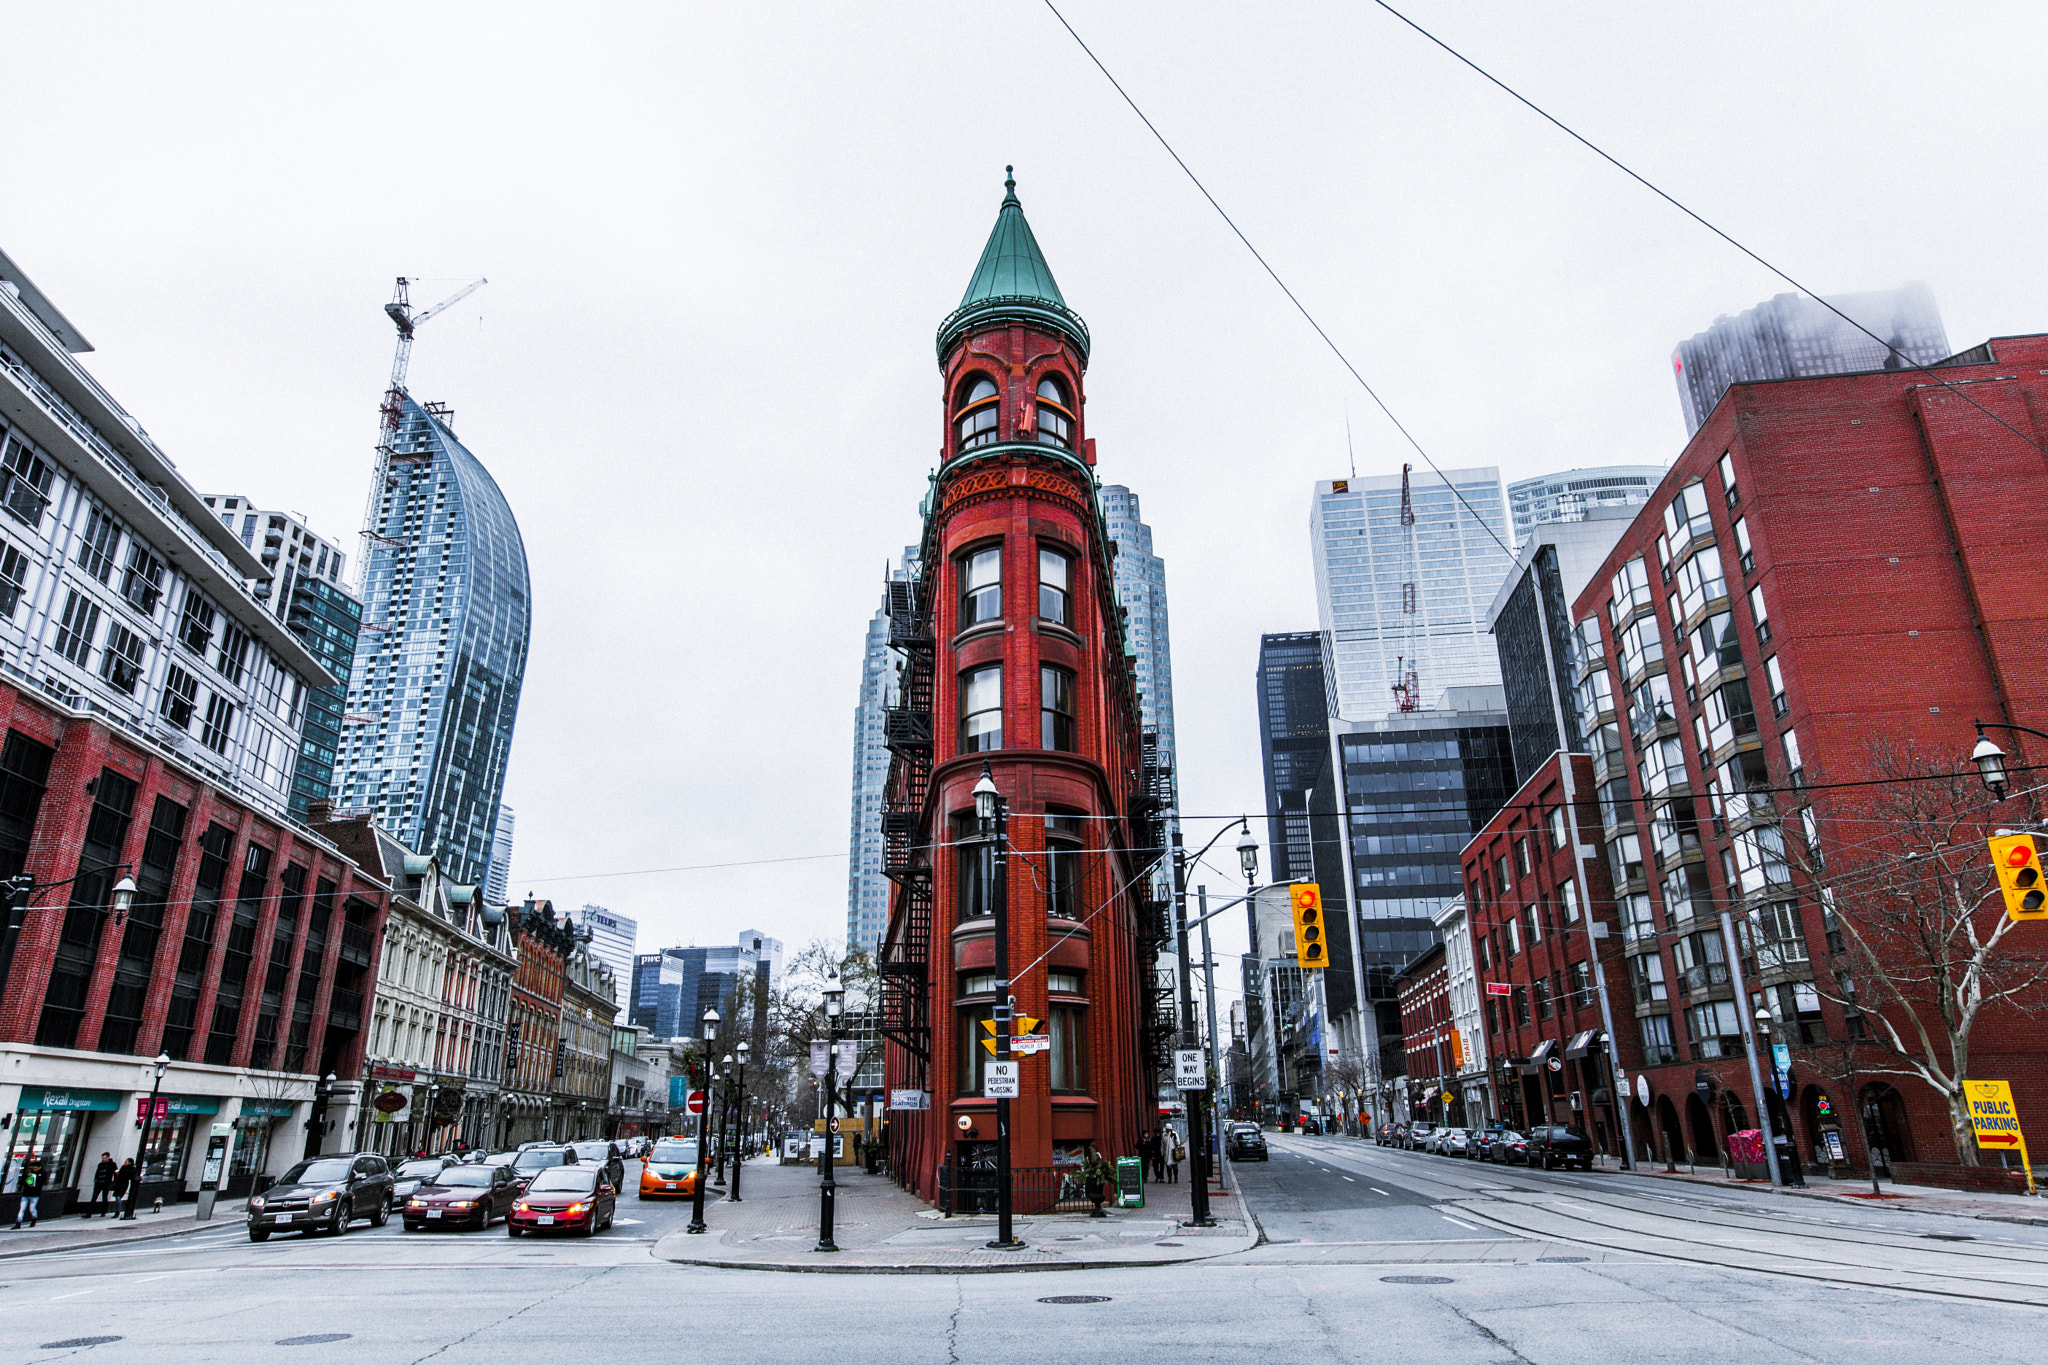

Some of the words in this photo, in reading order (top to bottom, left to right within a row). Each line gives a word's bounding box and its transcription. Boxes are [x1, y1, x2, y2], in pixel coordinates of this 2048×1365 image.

[597, 914, 617, 928] TELUS
[641, 956, 660, 965] pwc
[510, 1026, 520, 1066] WINNERS
[556, 1041, 566, 1075] WINNERS
[1182, 1053, 1198, 1062] ONE
[996, 1065, 1008, 1075] NO
[1183, 1065, 1198, 1074] WAY
[1178, 1077, 1205, 1086] BEGINS
[990, 1086, 1013, 1094] OSSING
[43, 1091, 70, 1107] Rexall
[69, 1098, 92, 1108] Drugstore
[1973, 1101, 2010, 1114] PUBLIC
[1973, 1117, 2018, 1130] PARKING
